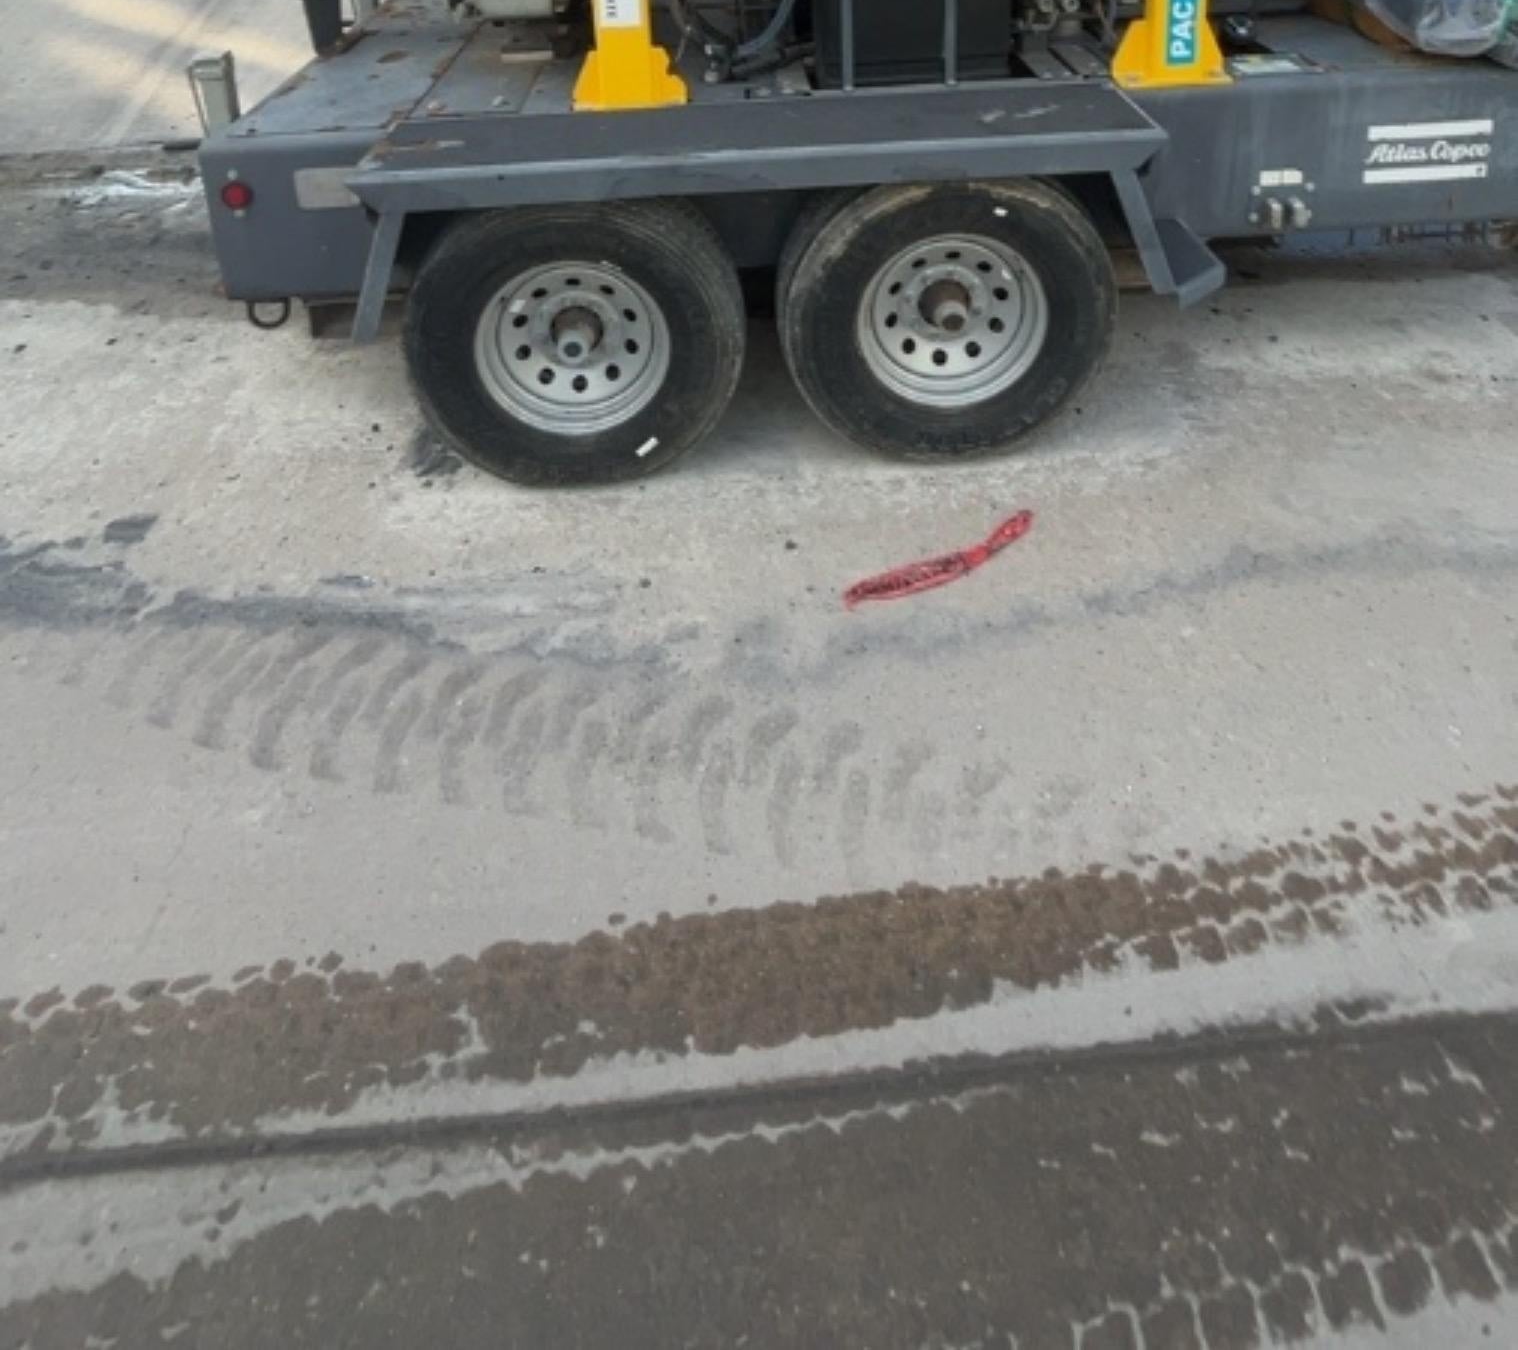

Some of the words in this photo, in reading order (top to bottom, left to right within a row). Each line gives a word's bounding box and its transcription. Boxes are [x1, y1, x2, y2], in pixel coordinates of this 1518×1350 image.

[1170, 0, 1195, 58] PAC
[1364, 143, 1428, 165] Atlas
[1430, 139, 1491, 163] Copco
